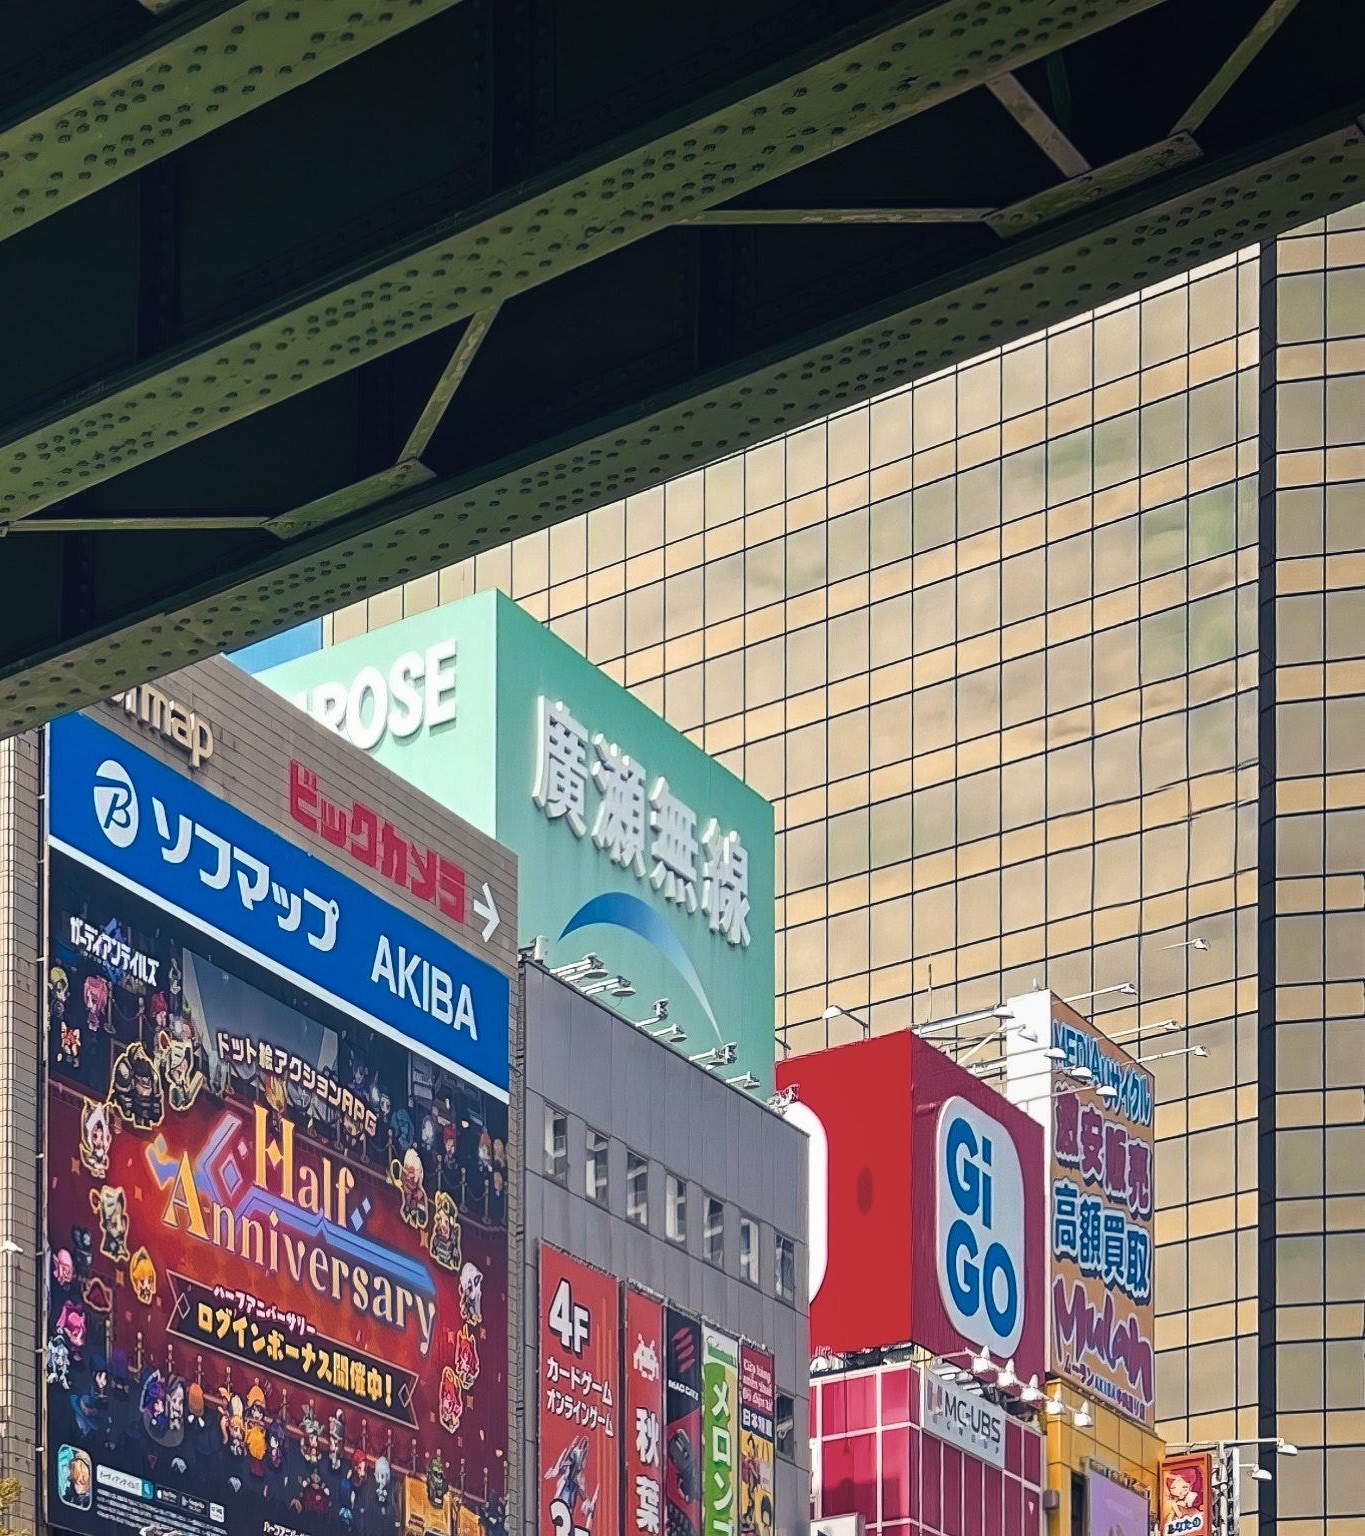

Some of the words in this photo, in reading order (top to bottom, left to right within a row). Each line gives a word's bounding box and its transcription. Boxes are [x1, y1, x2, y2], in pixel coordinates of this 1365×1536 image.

[288, 757, 466, 925] ビックカメラ
[534, 697, 753, 948] 廣瀬無線
[151, 796, 340, 953] ソフマップ
[370, 934, 479, 1041] AKIBA
[216, 1031, 379, 1139] ドット絵アクションRPG
[253, 1103, 355, 1226] Half
[161, 1150, 438, 1356] Anniversary
[1053, 1176, 1153, 1305] 高額買取
[213, 1284, 317, 1336] ハーフアニバーサリー
[548, 1276, 591, 1355] 4F
[545, 1387, 615, 1438] オンラインゲーム
[546, 1356, 614, 1407] カードゲーム
